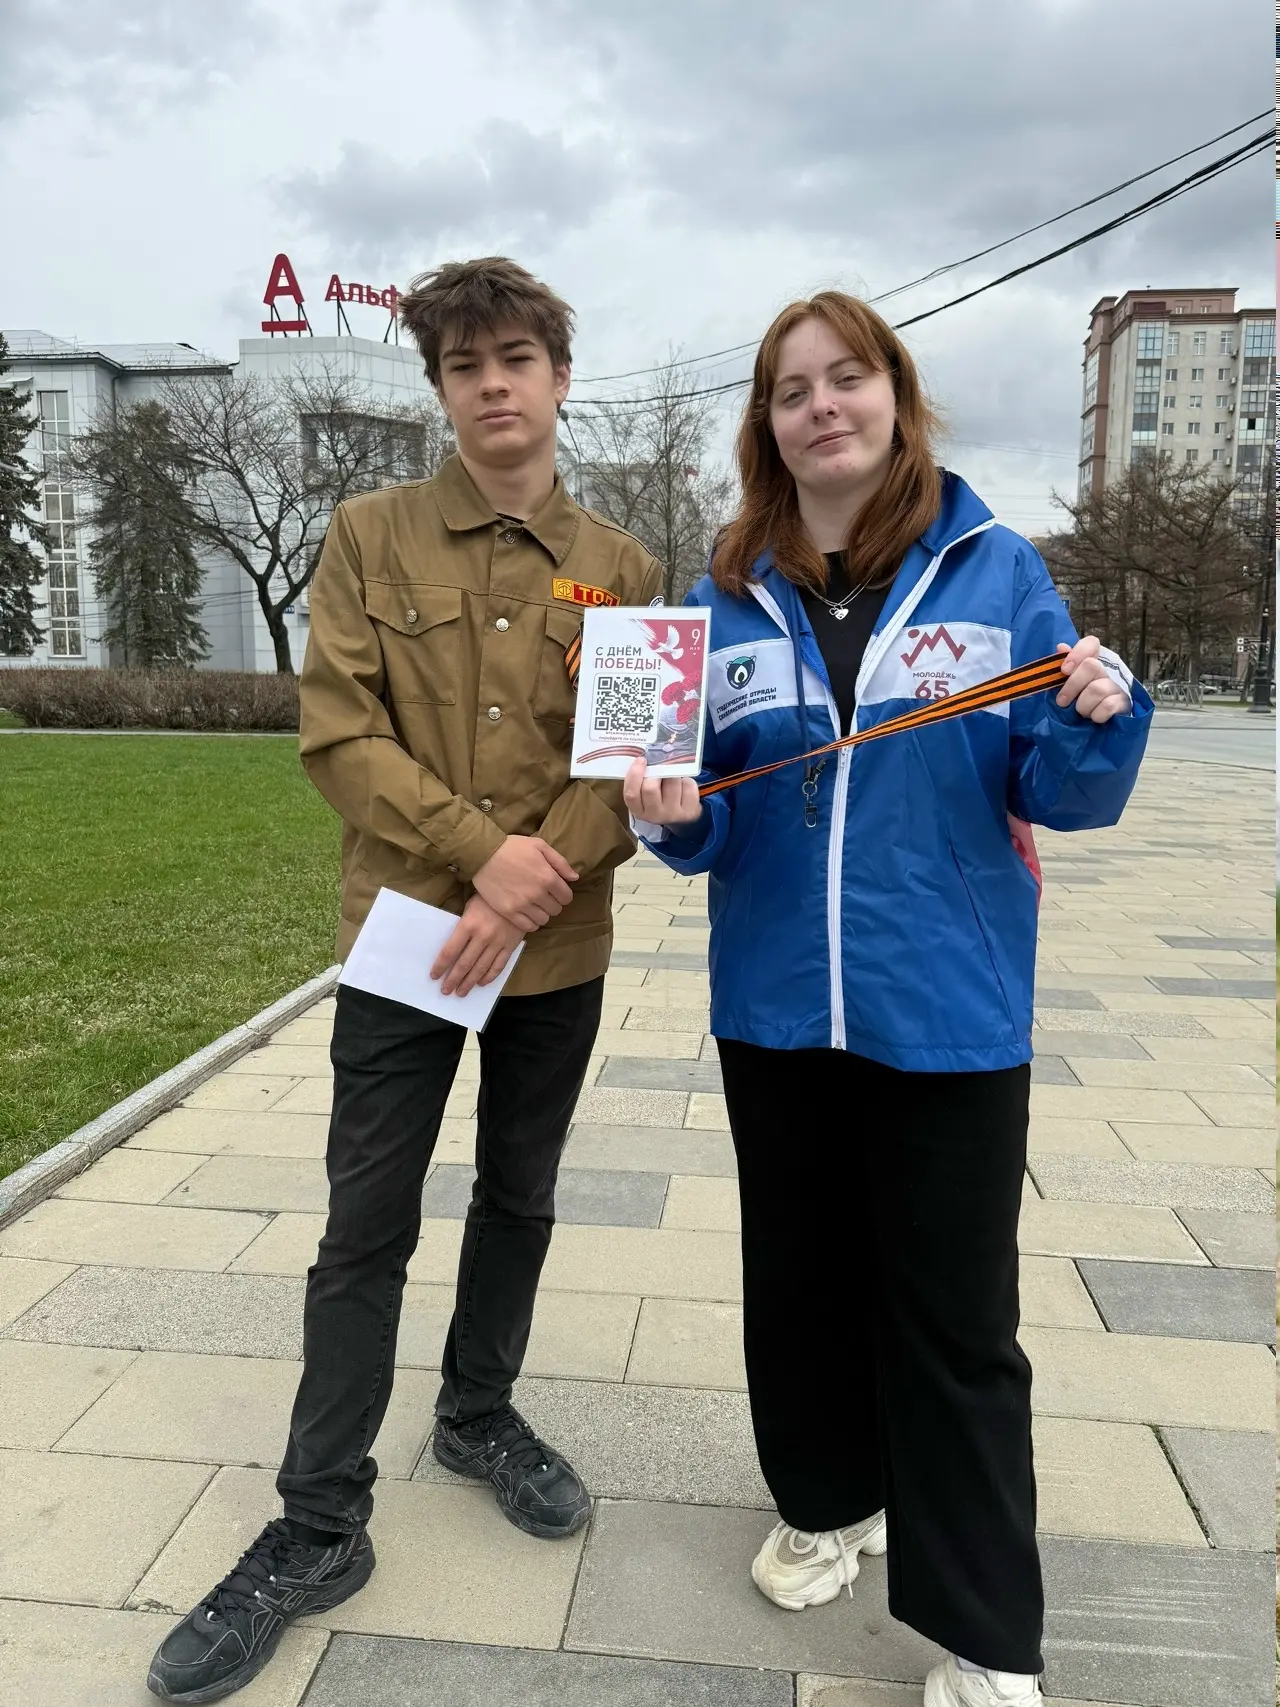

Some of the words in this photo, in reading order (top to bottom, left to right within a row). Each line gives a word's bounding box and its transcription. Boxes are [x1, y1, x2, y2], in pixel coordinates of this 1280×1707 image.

[691, 628, 701, 646] 9
[595, 646, 604, 656] С
[607, 645, 642, 657] ДНЁМ
[594, 658, 661, 671] ПОБЕДЫ!
[913, 671, 956, 679] МОЛОДЁЖЬ
[749, 687, 777, 698] ОТРЯДЫ
[915, 680, 950, 700] 65
[748, 694, 777, 706] ОБЛАСТИ
